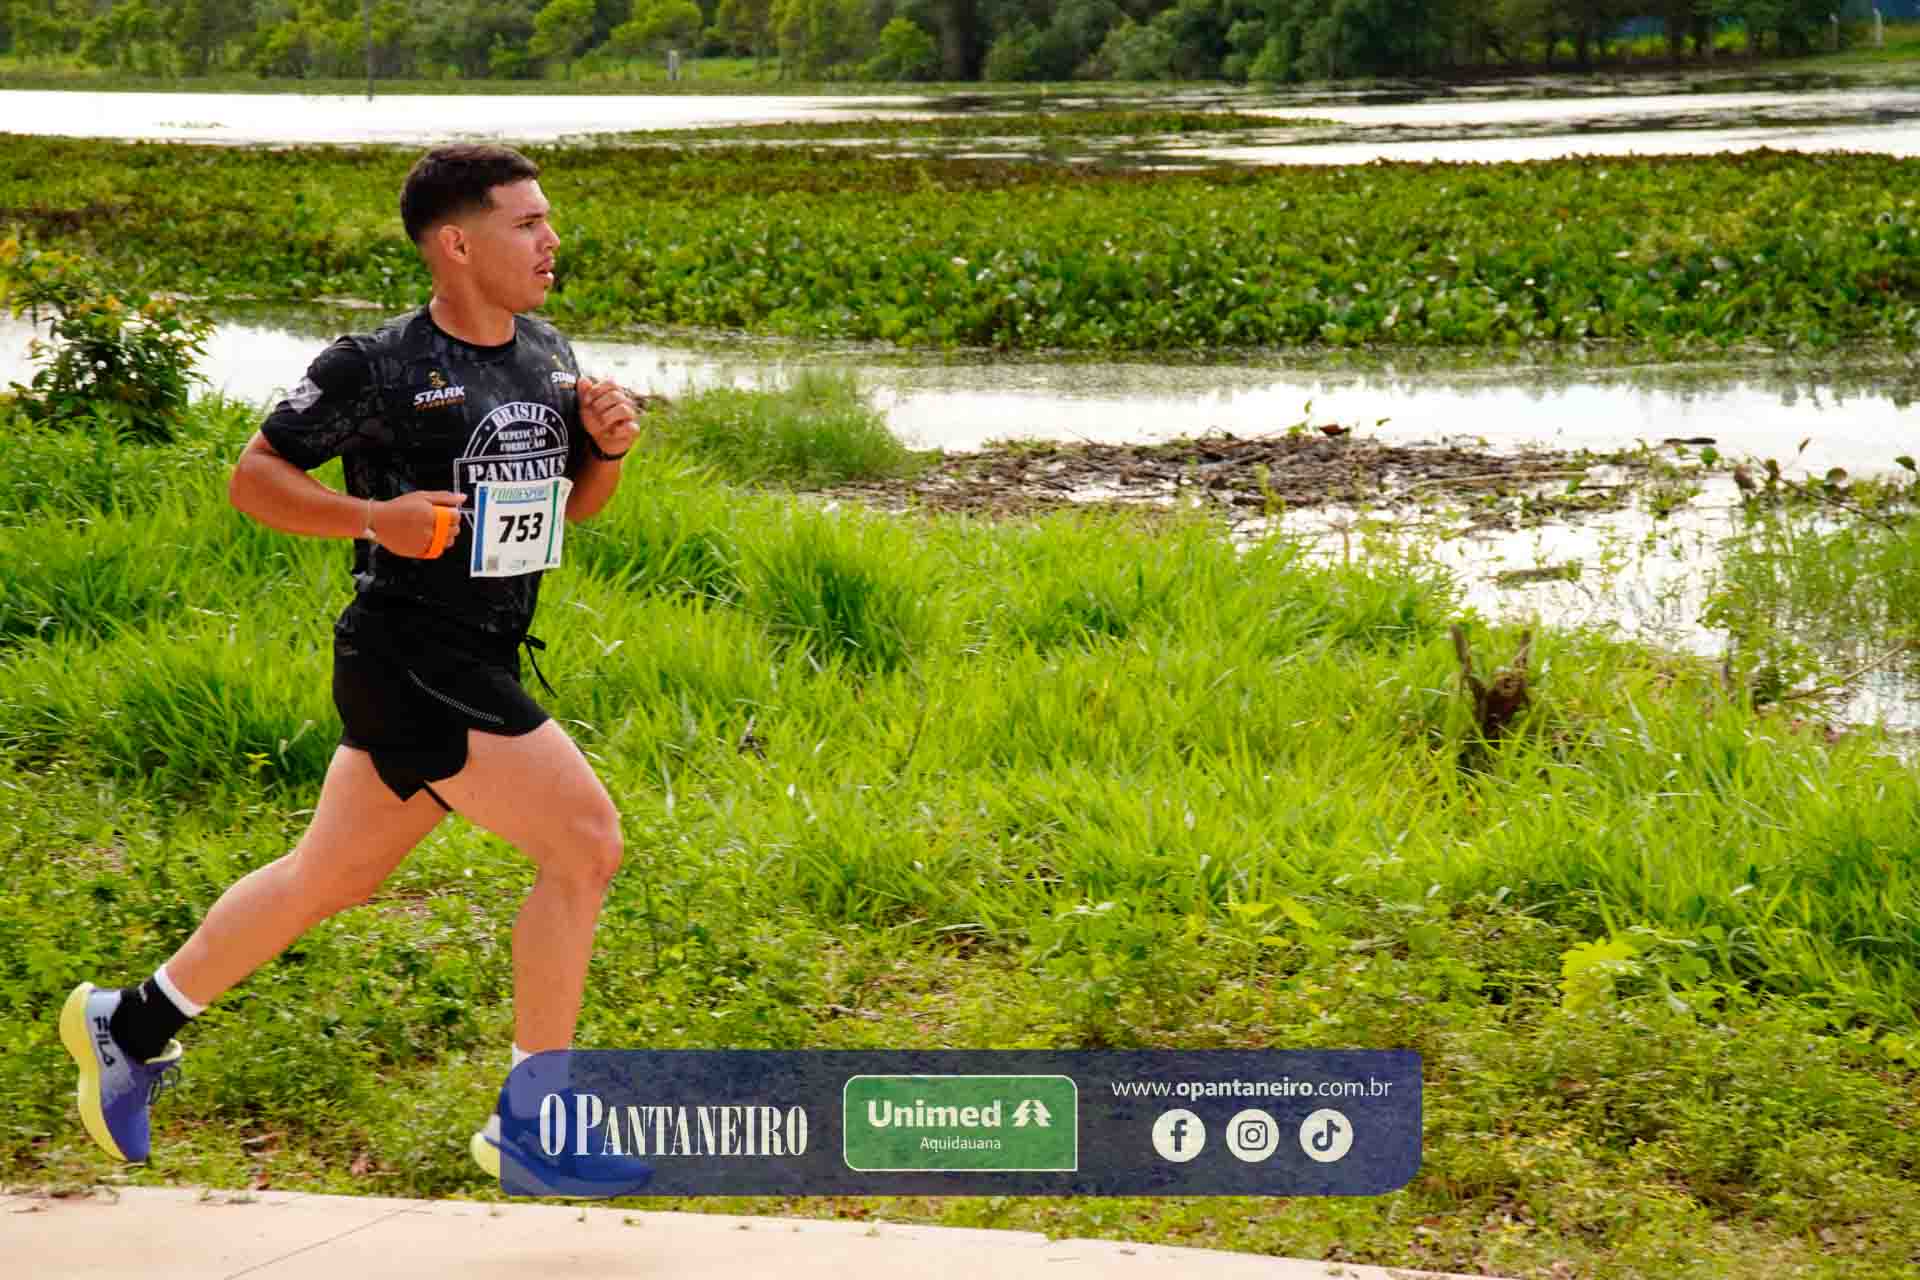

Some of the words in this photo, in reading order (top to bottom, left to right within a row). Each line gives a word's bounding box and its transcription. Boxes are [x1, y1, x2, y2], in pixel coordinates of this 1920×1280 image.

[413, 386, 465, 407] STARK
[499, 512, 544, 544] 753
[93, 1016, 115, 1067] FILA
